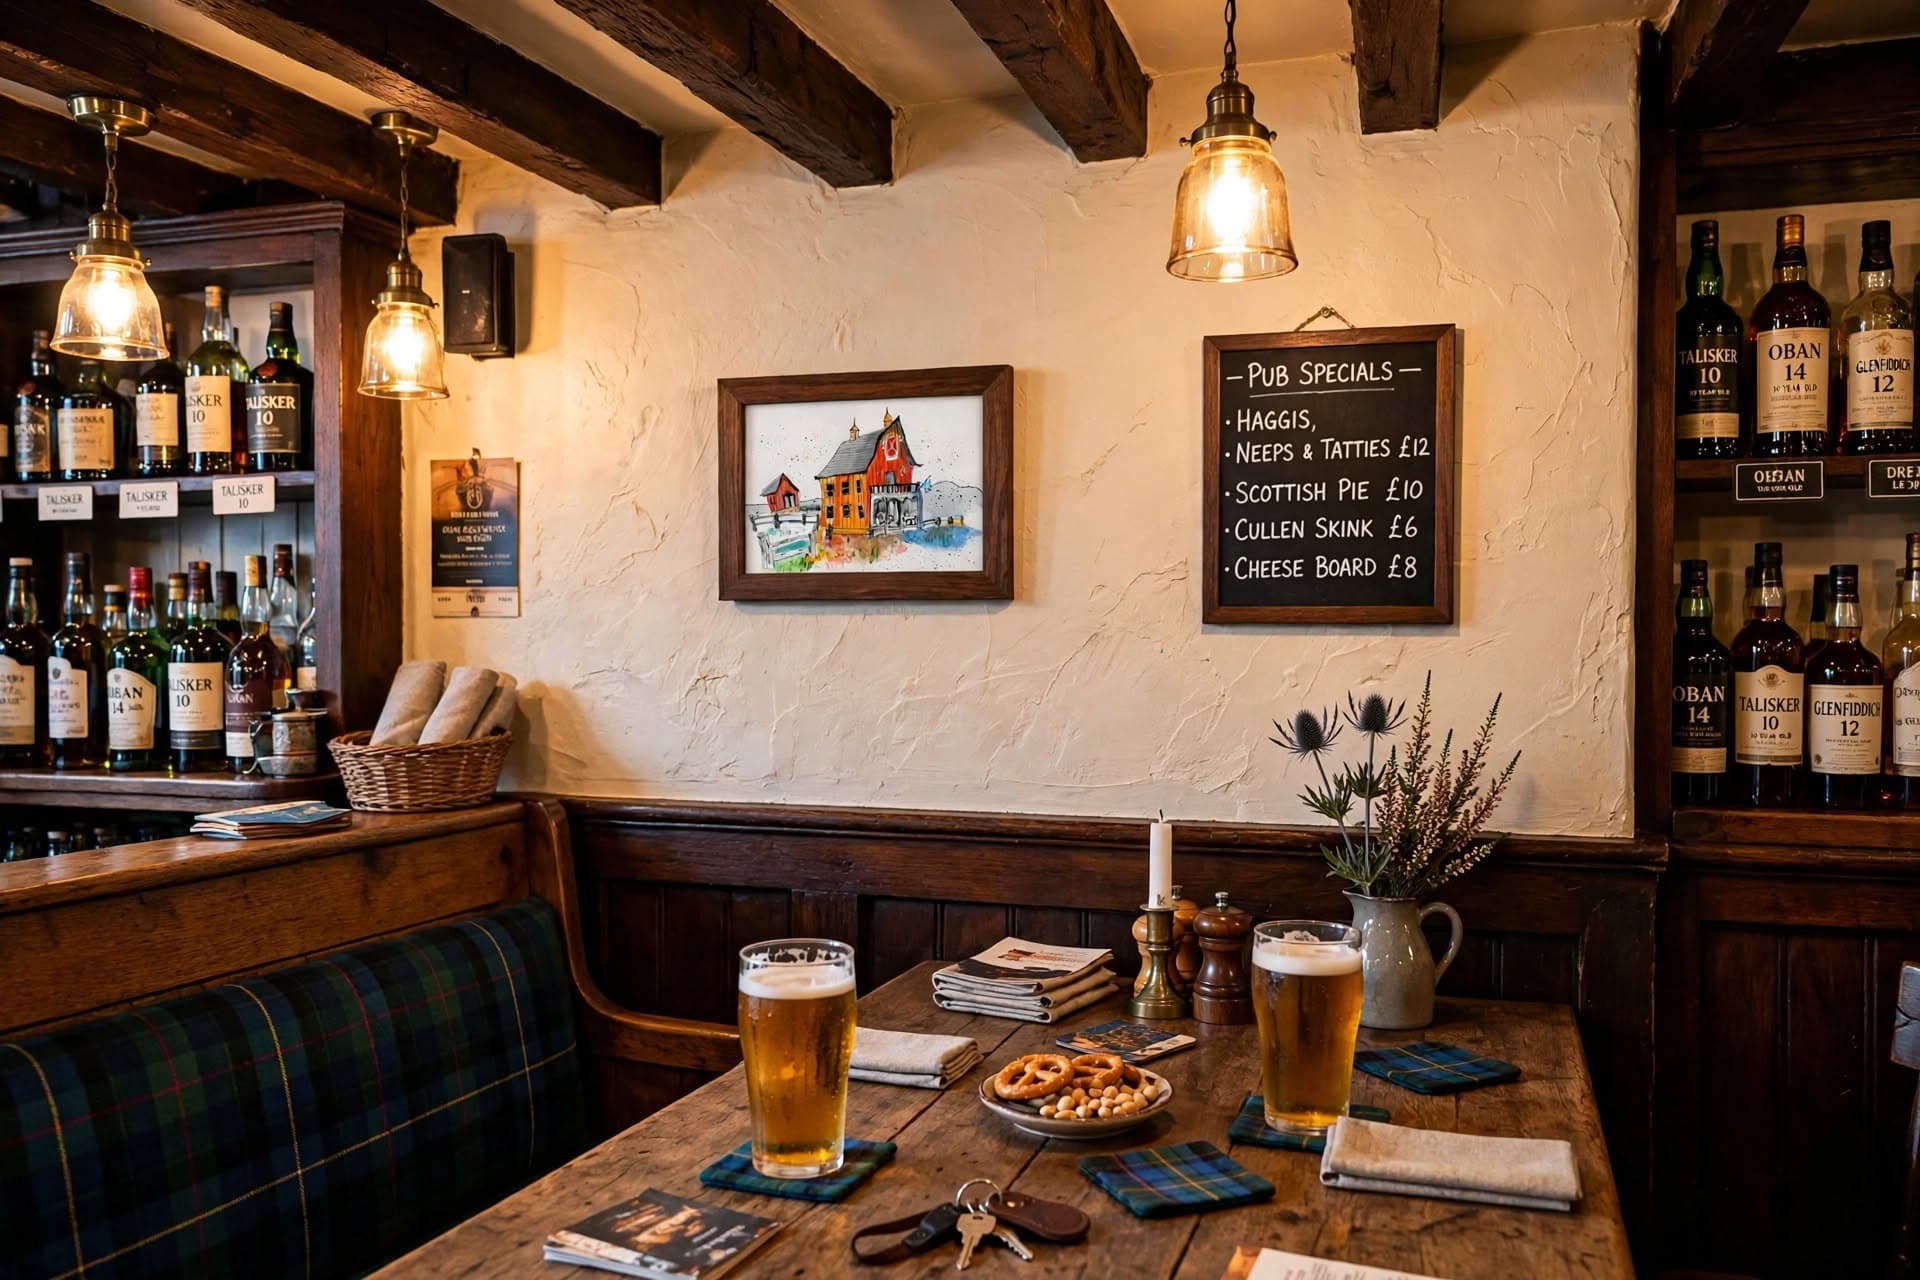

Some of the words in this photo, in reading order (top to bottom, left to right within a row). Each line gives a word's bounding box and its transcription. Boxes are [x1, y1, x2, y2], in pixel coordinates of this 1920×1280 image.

[1679, 348, 1738, 364] TALISKER
[1768, 343, 1822, 360] OBAN
[1248, 362, 1289, 388] PUB
[1299, 361, 1392, 385] SPECIALS
[1699, 366, 1721, 384] 10
[1785, 363, 1807, 381] 14
[1872, 375, 1895, 393] 12
[192, 409, 206, 423] 10
[255, 411, 274, 426] 10
[1238, 409, 1315, 432] HAGGIS,
[1237, 441, 1293, 463] NEEPS
[1303, 444, 1312, 460] &
[1320, 438, 1390, 459] TATTIES
[1399, 435, 1430, 458] £12
[126, 490, 168, 503] TALISKER
[221, 484, 264, 497] TALISKER
[1236, 481, 1325, 504] SCOTTISH
[1339, 478, 1369, 501] PIE
[1386, 477, 1422, 501] £10
[238, 498, 249, 508] 10
[1235, 518, 1304, 540] CULLEN
[1316, 517, 1373, 538] SKINK
[1389, 515, 1417, 538] £6
[1235, 557, 1304, 579] CHEESE
[1316, 556, 1376, 578] BOARD
[1388, 554, 1416, 578] £8
[176, 695, 190, 707] 10
[1673, 686, 1725, 702] OBAN
[113, 702, 124, 713] 14
[1740, 697, 1800, 712] TALISKER
[1688, 707, 1711, 723] 14
[1762, 716, 1779, 730] 10
[1841, 720, 1860, 736] 12
